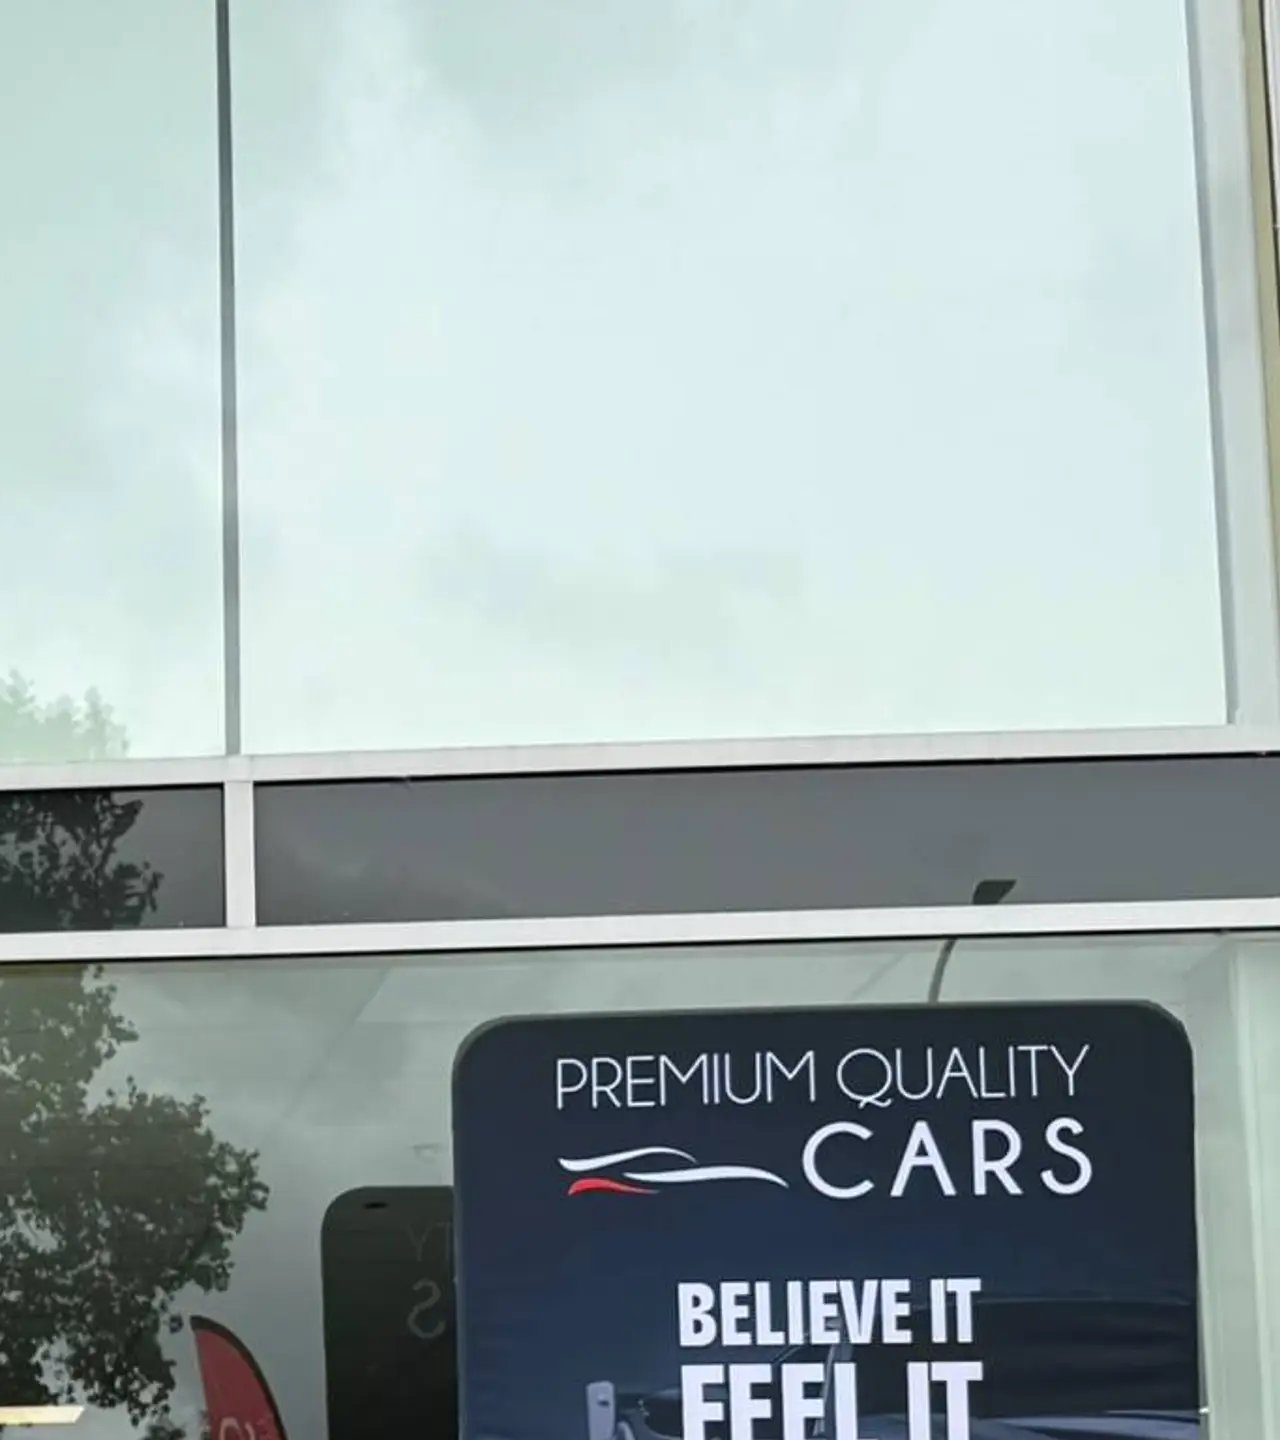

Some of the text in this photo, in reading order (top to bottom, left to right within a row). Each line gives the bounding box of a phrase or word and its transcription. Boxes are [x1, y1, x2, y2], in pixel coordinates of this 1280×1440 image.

[557, 1044, 1091, 1110] PREMIUM QUALITY
[802, 1117, 1093, 1198] CARS
[677, 1278, 982, 1347] BELIEVE IT
